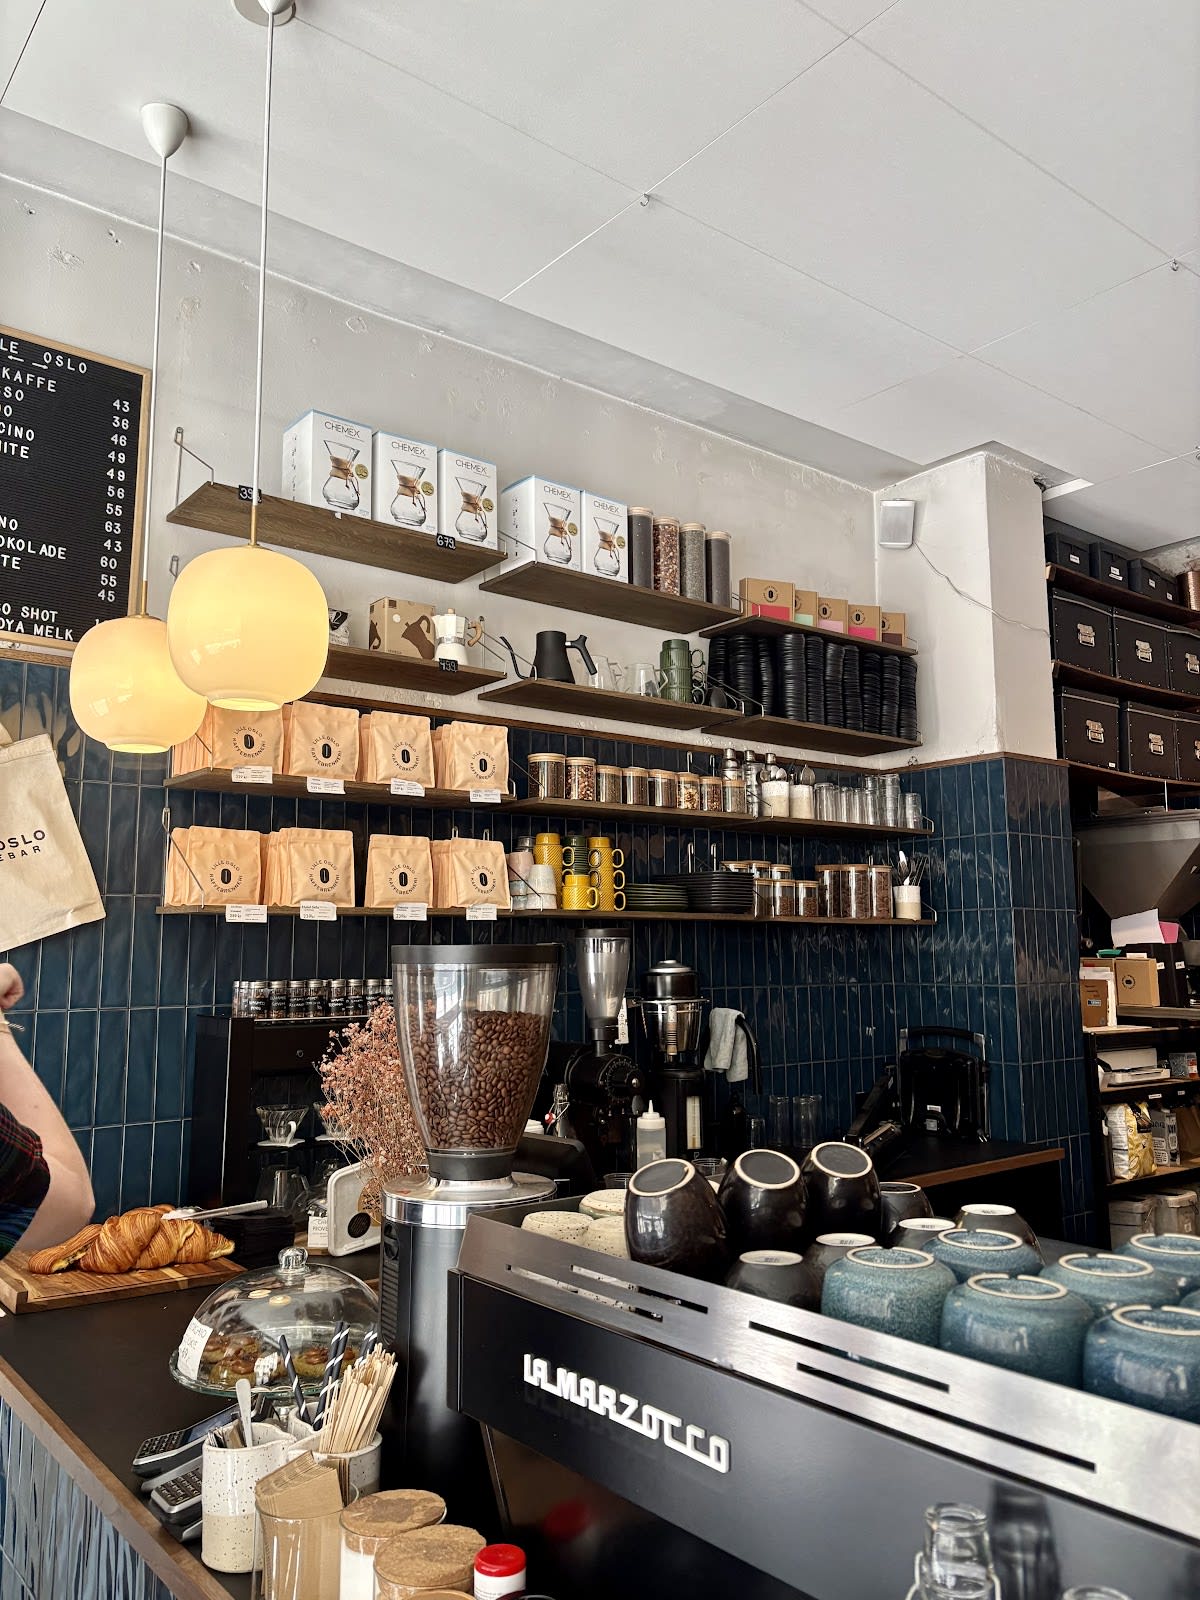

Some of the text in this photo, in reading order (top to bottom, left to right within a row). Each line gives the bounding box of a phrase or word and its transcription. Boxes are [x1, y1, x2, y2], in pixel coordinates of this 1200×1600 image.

[0, 338, 87, 374] LE OSLO
[2, 366, 130, 413] KAFFE 43
[0, 386, 129, 430] SO 36
[0, 404, 127, 447] O 46
[324, 421, 360, 438] CHEMEX
[0, 421, 126, 464] CINO 49
[391, 441, 426, 456] CHEMEX
[0, 440, 126, 482] ITE 49
[456, 459, 488, 474] CHEMEX
[106, 485, 125, 499] 56
[544, 485, 572, 500] CHEMEX
[105, 503, 123, 517] 55
[594, 500, 620, 513] CHEMEX
[104, 521, 122, 534] 63
[103, 539, 122, 553] 43
[0, 554, 117, 588] TE 55
[100, 556, 118, 569] 60
[97, 589, 116, 602] 45
[0, 602, 58, 623] O SHOT
[0, 617, 74, 641] OYA MELK
[0, 829, 45, 851] OSLO
[524, 1353, 550, 1388] LA
